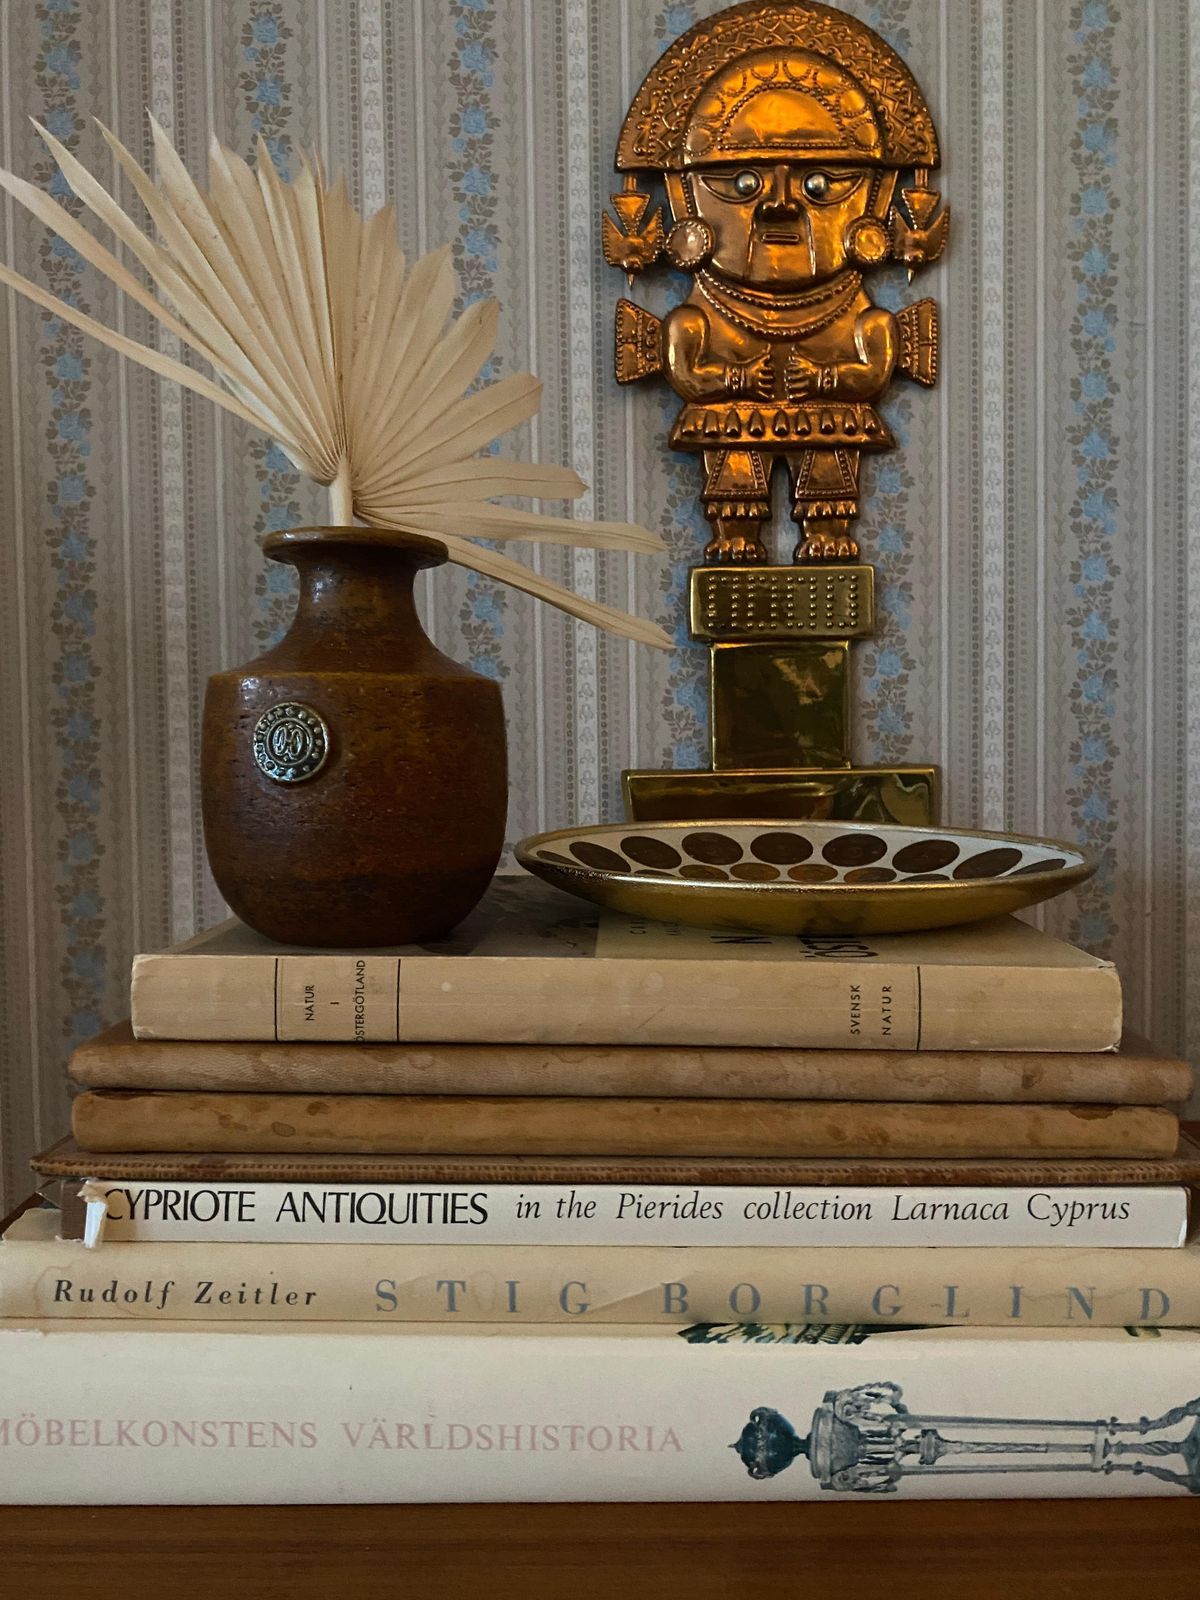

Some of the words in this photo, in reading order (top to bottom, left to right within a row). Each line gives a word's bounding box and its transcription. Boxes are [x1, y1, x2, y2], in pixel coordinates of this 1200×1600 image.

[304, 984, 315, 1021] NATUR
[849, 984, 861, 1035] SVENSK
[881, 985, 892, 1036] NATUR
[104, 1188, 256, 1222] CYPRIOTE
[275, 1191, 489, 1225] ANTIQUITIES
[515, 1194, 542, 1219] in
[556, 1190, 597, 1219] the
[616, 1191, 724, 1222] Pierides
[743, 1192, 872, 1222] collection
[892, 1194, 1010, 1222] Larnaca
[1027, 1192, 1131, 1226] Cyprus
[54, 1279, 175, 1308] Rudolf
[195, 1281, 319, 1307] Zeitler
[341, 1416, 683, 1454] VÄRLDSHISTORIA
